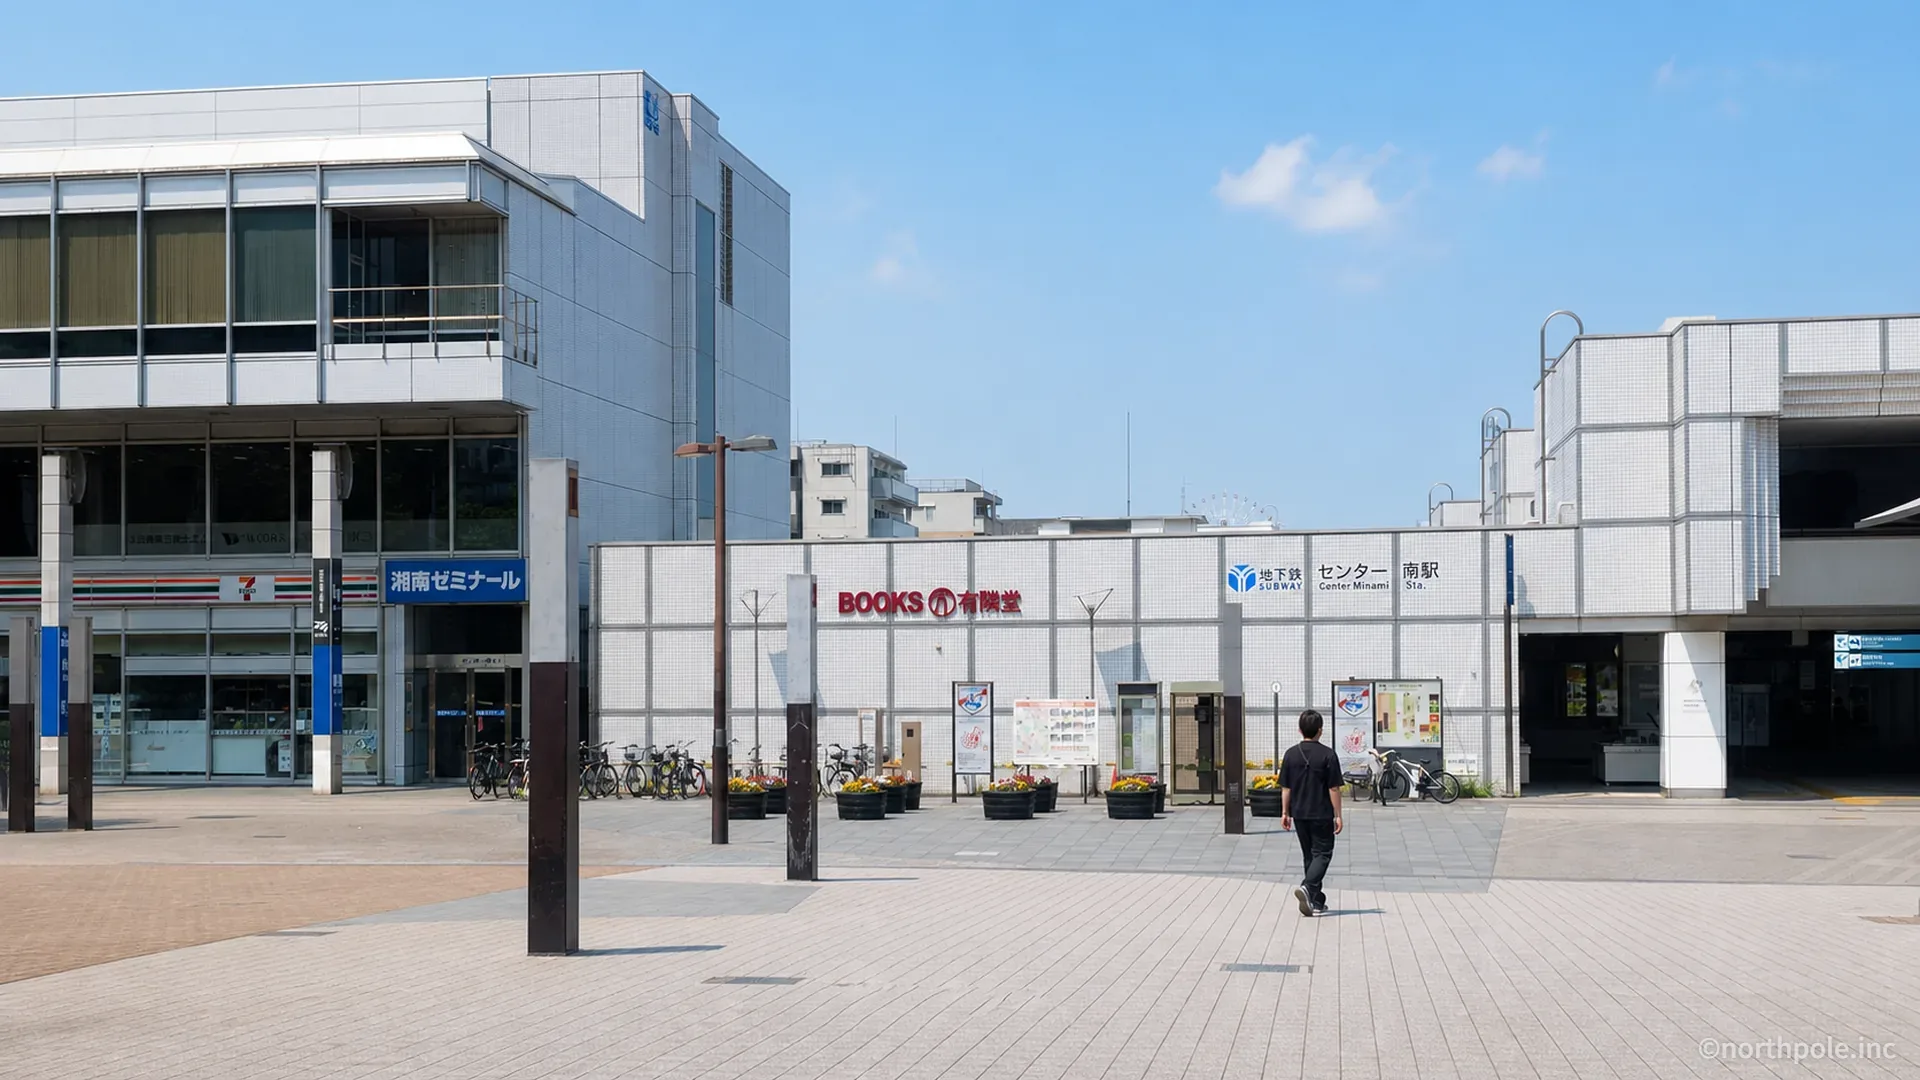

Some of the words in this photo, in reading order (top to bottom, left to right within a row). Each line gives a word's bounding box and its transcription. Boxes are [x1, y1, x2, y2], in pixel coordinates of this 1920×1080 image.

[1259, 568, 1303, 581] 地下鉄
[1318, 563, 1388, 580] センター
[1402, 562, 1439, 579] 南駅
[391, 570, 520, 592] 湘南ゼミナール
[1259, 581, 1303, 591] SUBWAY
[1319, 581, 1350, 591] Center
[1353, 581, 1389, 590] Minami
[1406, 581, 1427, 590] Sta.
[838, 591, 924, 614] BOOKS
[957, 590, 1022, 614] 有隣堂
